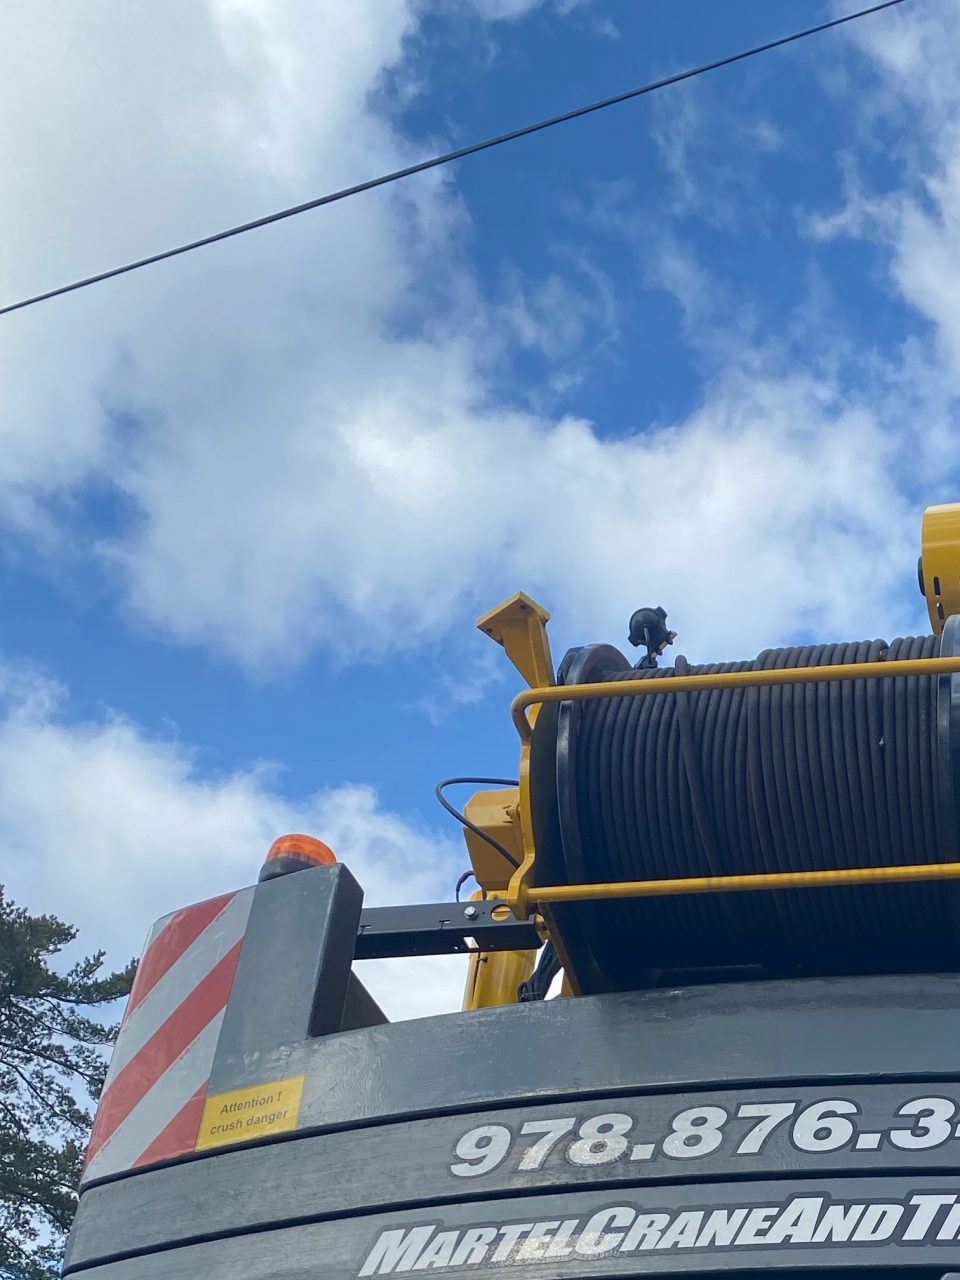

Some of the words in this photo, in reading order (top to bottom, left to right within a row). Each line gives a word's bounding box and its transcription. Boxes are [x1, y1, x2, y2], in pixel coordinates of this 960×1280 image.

[220, 1095, 273, 1115] Attention
[210, 1118, 243, 1135] crush
[246, 1110, 289, 1127] danger
